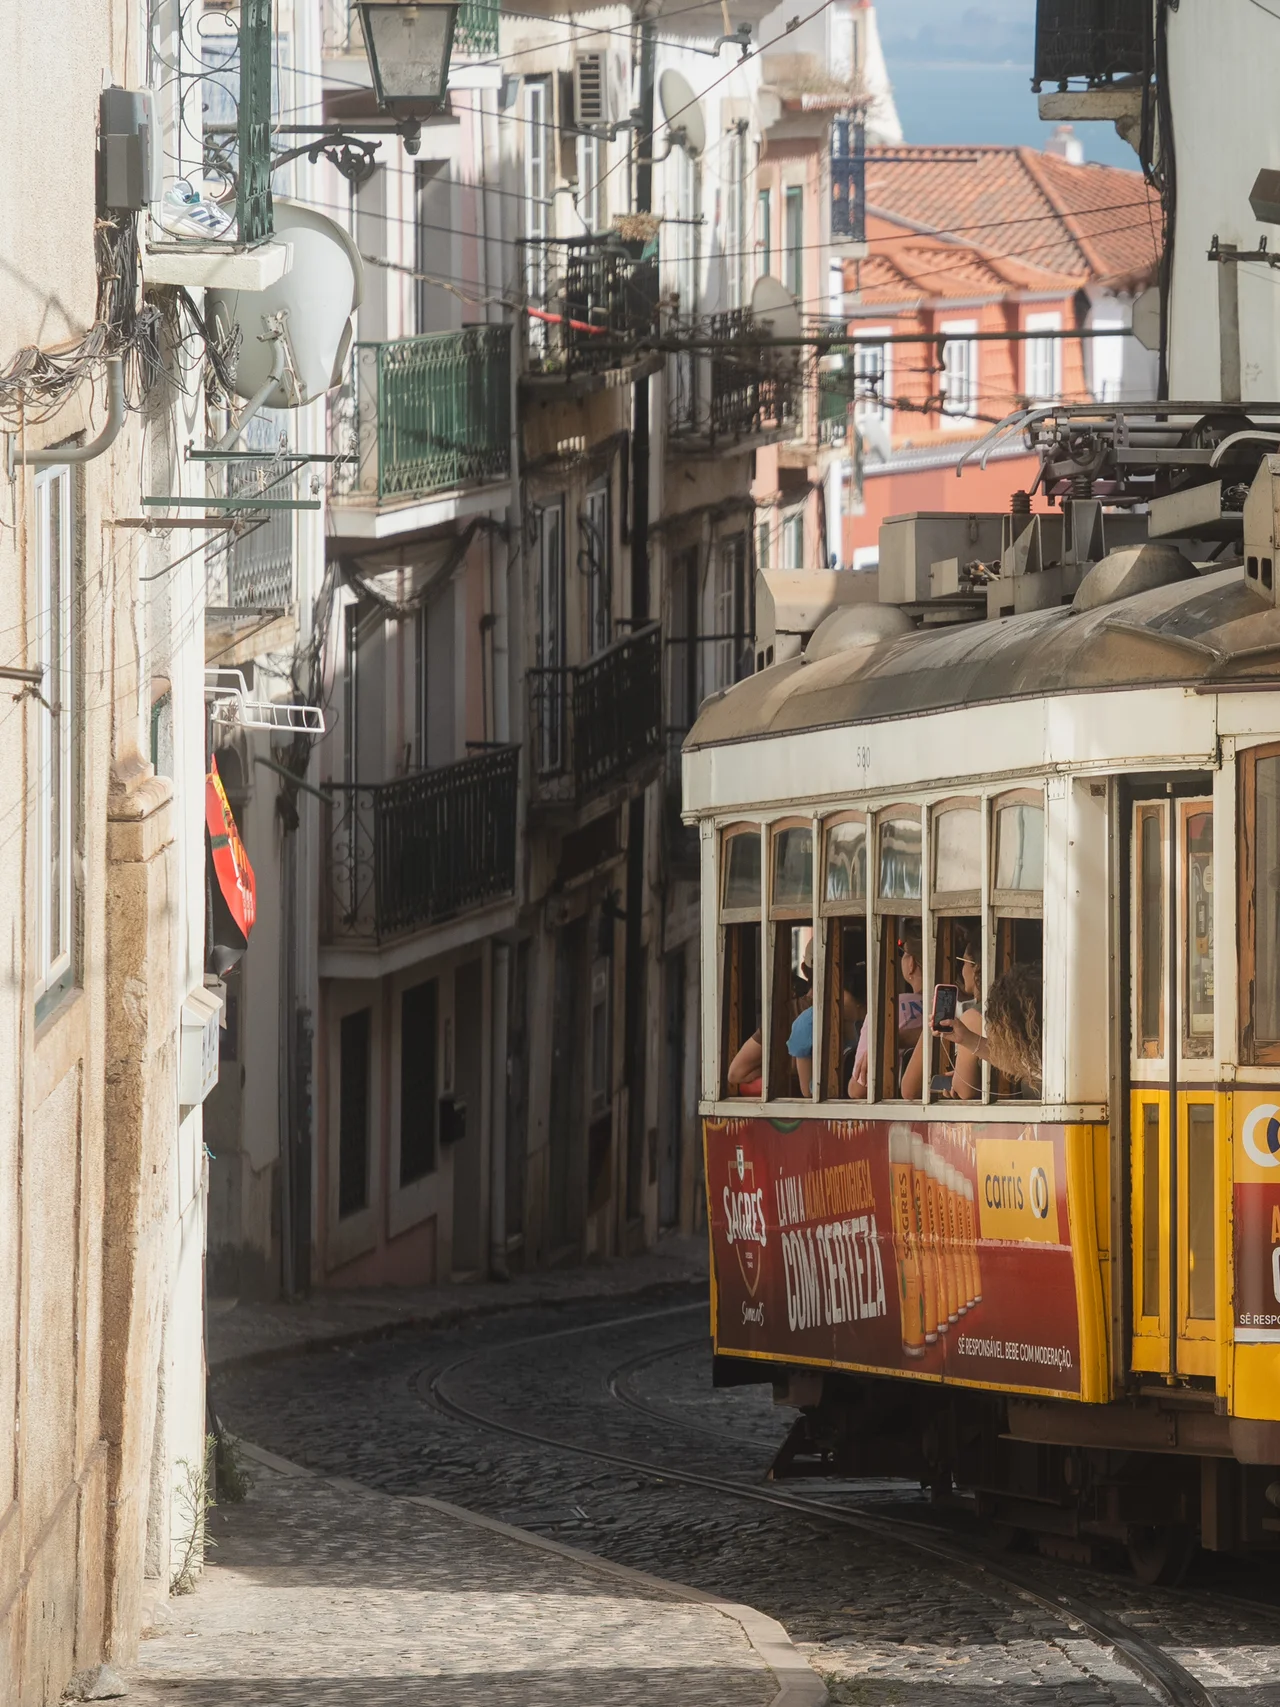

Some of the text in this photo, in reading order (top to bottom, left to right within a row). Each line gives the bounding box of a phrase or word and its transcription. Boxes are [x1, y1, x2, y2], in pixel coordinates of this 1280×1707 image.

[857, 746, 870, 768] 580
[775, 1166, 788, 1228] LÁ
[785, 1175, 800, 1225] VAI
[798, 1174, 806, 1222] A
[804, 1168, 827, 1221] ALMA
[985, 1160, 1024, 1211] carris
[723, 1186, 767, 1247] SAGRES
[898, 1172, 913, 1261] SAGRES
[781, 1228, 821, 1332] COM
[815, 1213, 887, 1326] CERTEZA
[1239, 1311, 1251, 1325] SÊ
[965, 1335, 1005, 1359] RESPONSÁVEL.
[1005, 1341, 1020, 1361] BEBE
[1019, 1343, 1034, 1362] COM
[1034, 1344, 1073, 1373] MODERAÇÃO.
